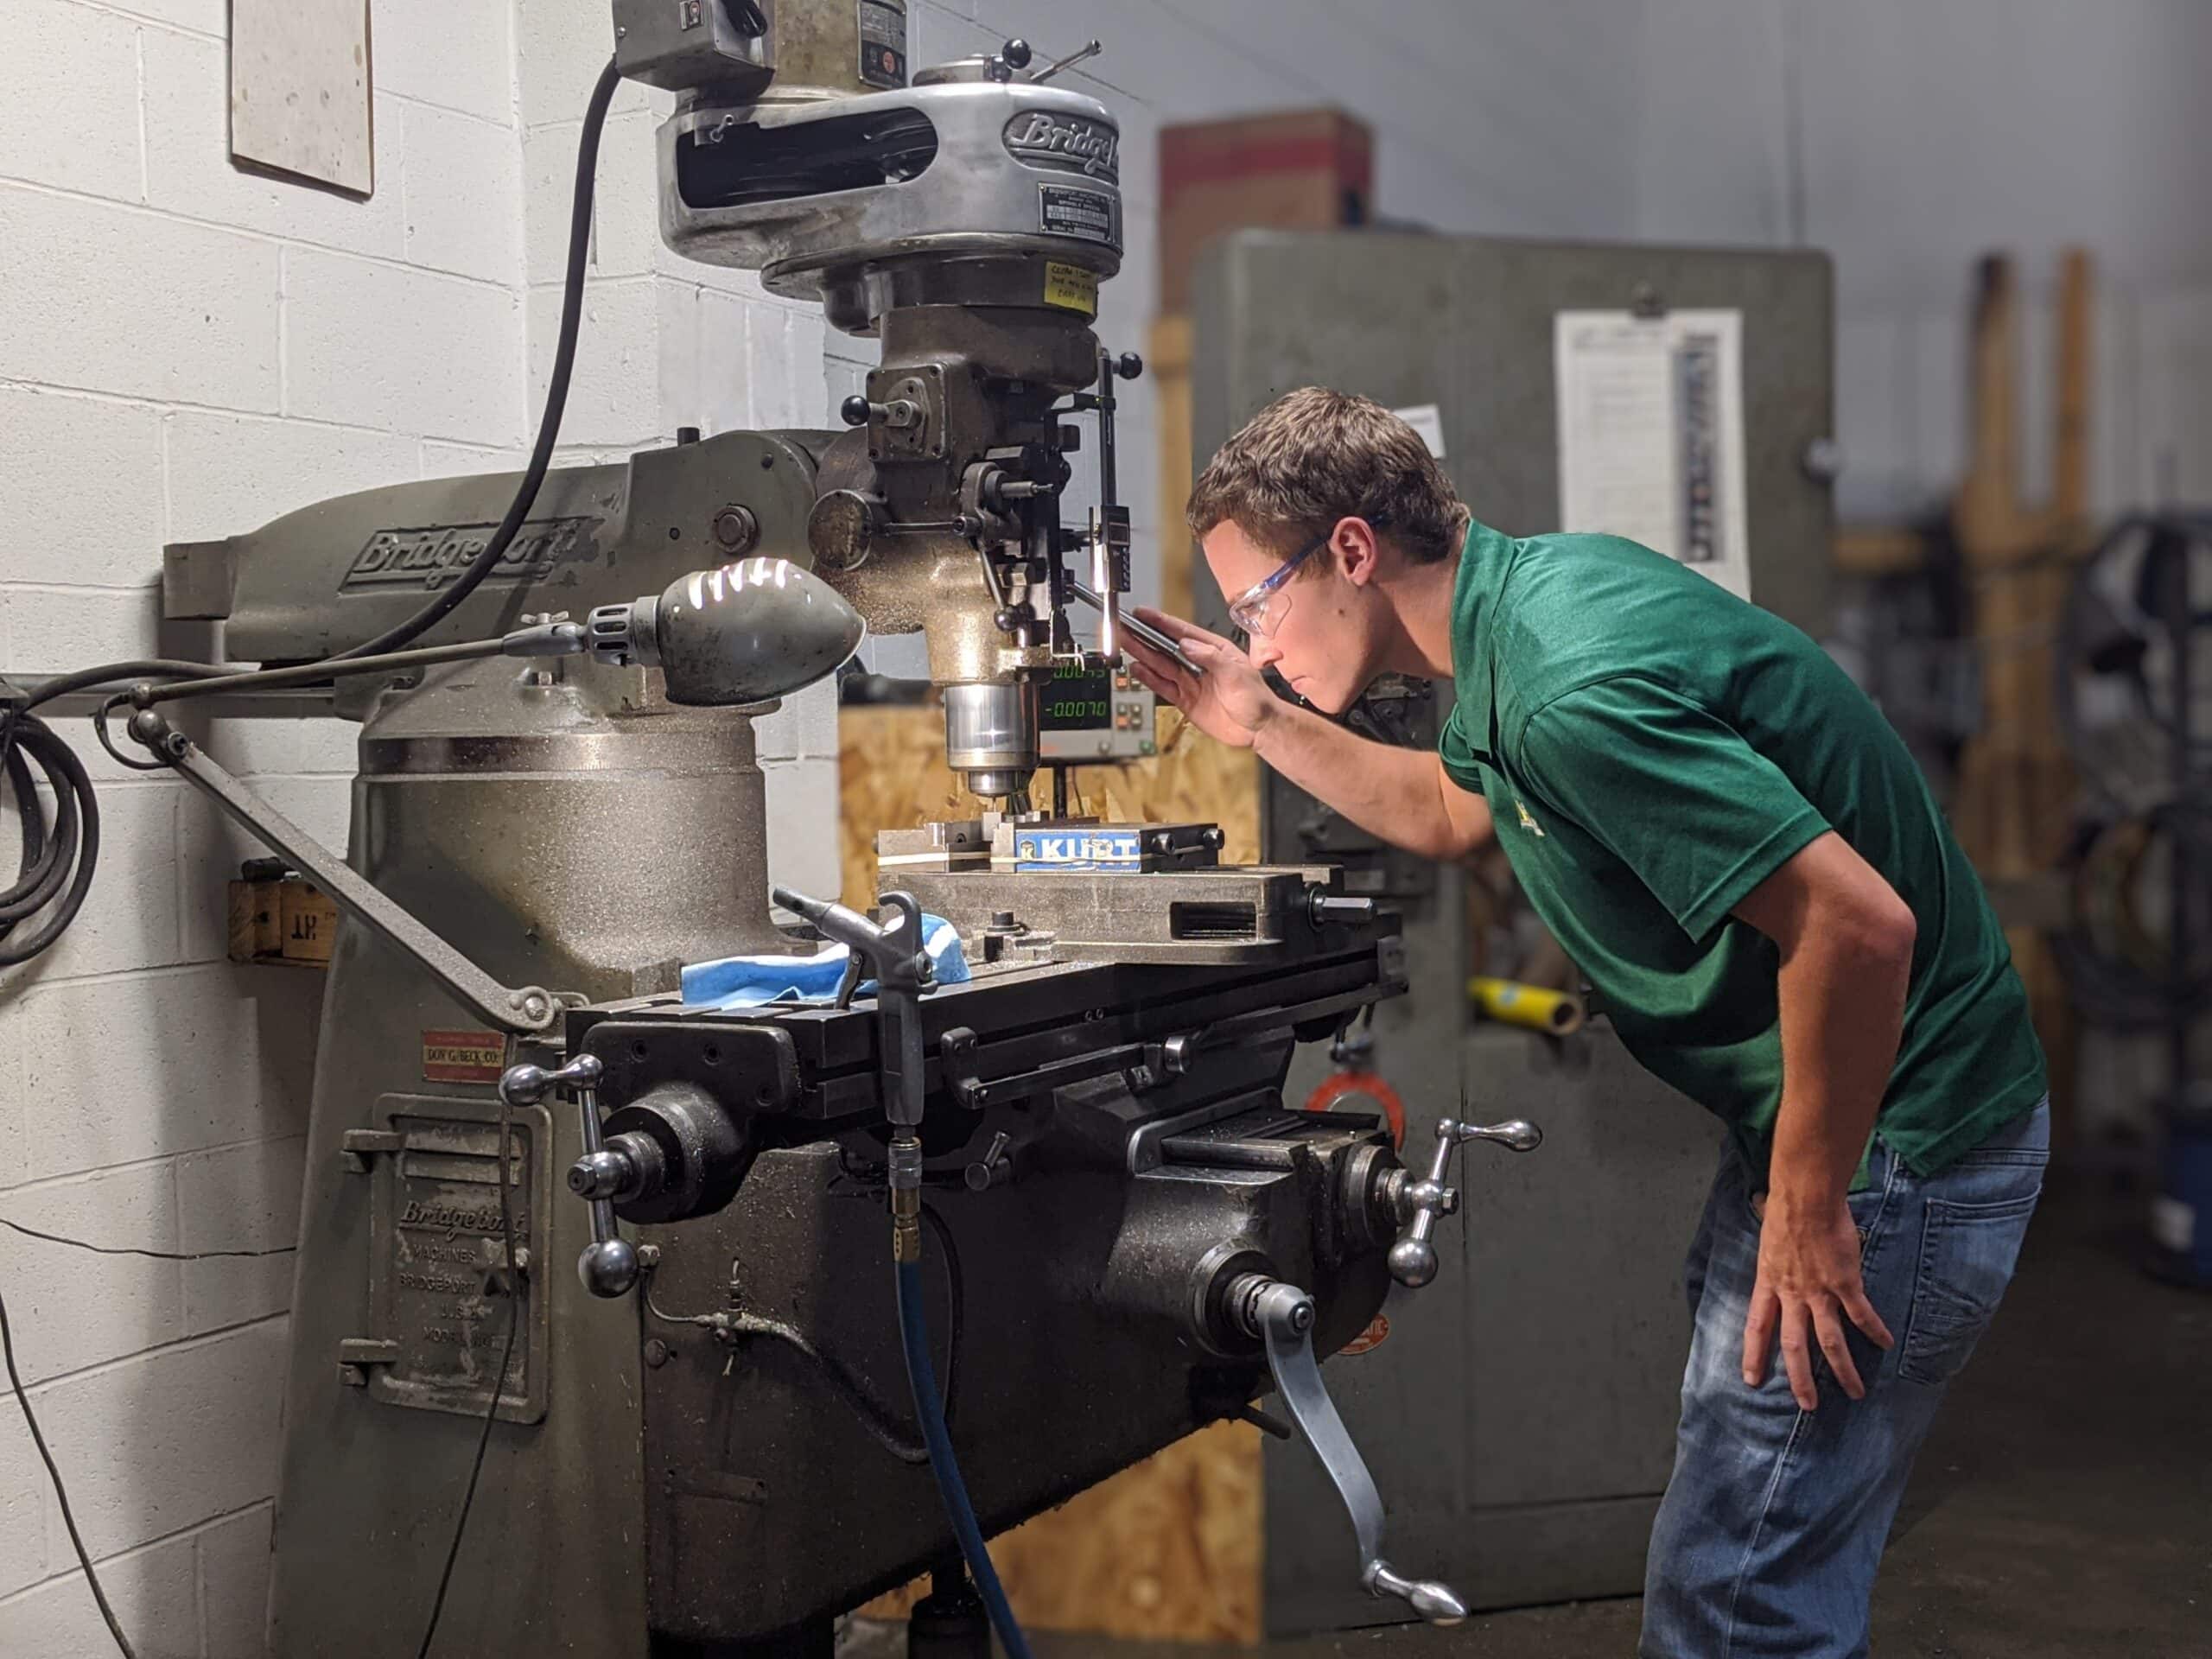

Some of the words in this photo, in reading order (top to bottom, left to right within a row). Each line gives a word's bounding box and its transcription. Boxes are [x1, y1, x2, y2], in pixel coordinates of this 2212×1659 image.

[351, 518, 577, 590] Bridgeort
[1041, 838, 1137, 865] KURT
[400, 1199, 528, 1243] Bridgepot
[413, 1243, 477, 1264] MACHINES
